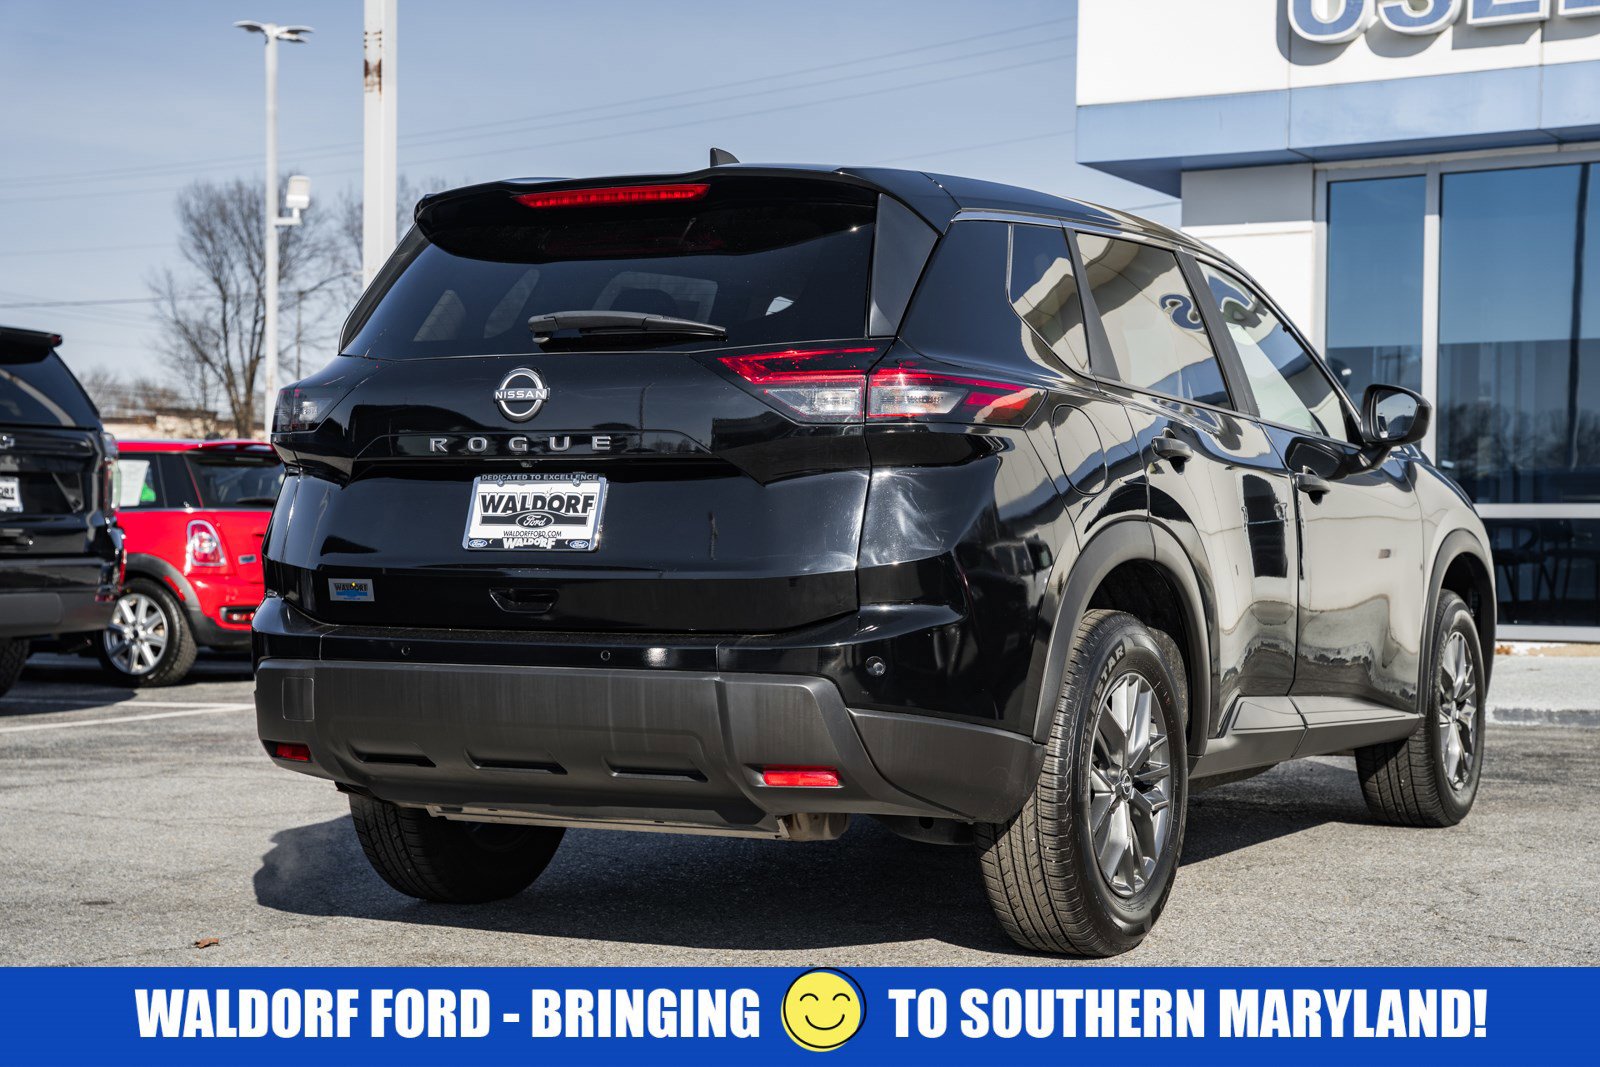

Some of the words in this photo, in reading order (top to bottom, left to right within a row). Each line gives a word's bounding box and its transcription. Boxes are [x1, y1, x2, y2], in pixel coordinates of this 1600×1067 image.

[495, 389, 546, 399] NISSAN
[429, 436, 612, 452] ROGUE
[480, 494, 596, 514] WALDORF
[523, 515, 547, 526] Ford
[503, 537, 556, 549] WALDORF
